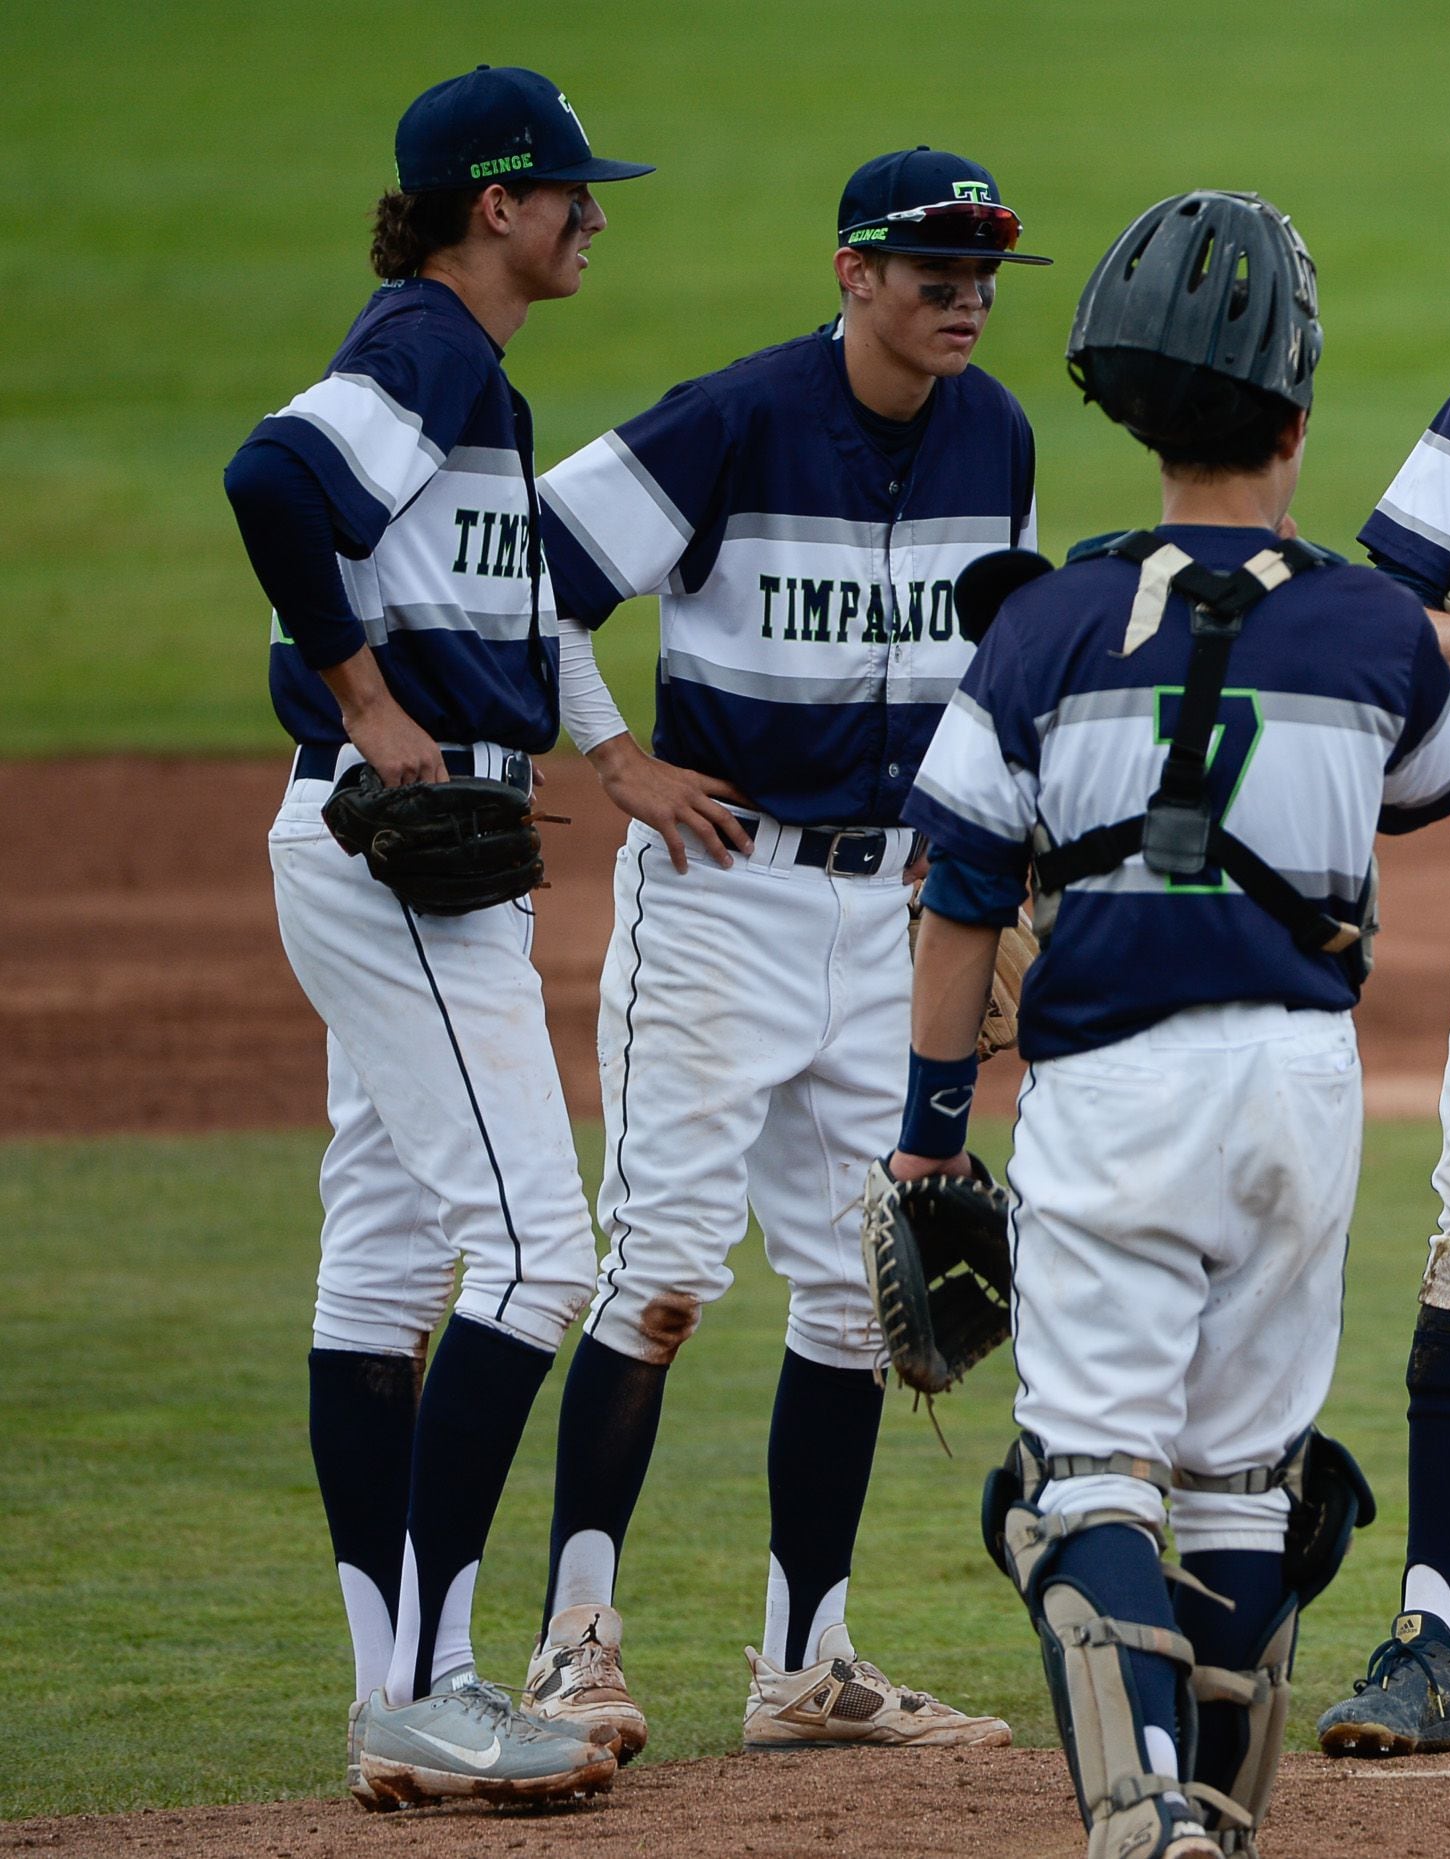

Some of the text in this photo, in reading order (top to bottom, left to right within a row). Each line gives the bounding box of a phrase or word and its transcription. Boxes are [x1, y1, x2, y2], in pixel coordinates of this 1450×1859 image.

[470, 152, 534, 179] GEINGE
[760, 573, 977, 644] TIMPANO
[1153, 684, 1265, 894] 7
